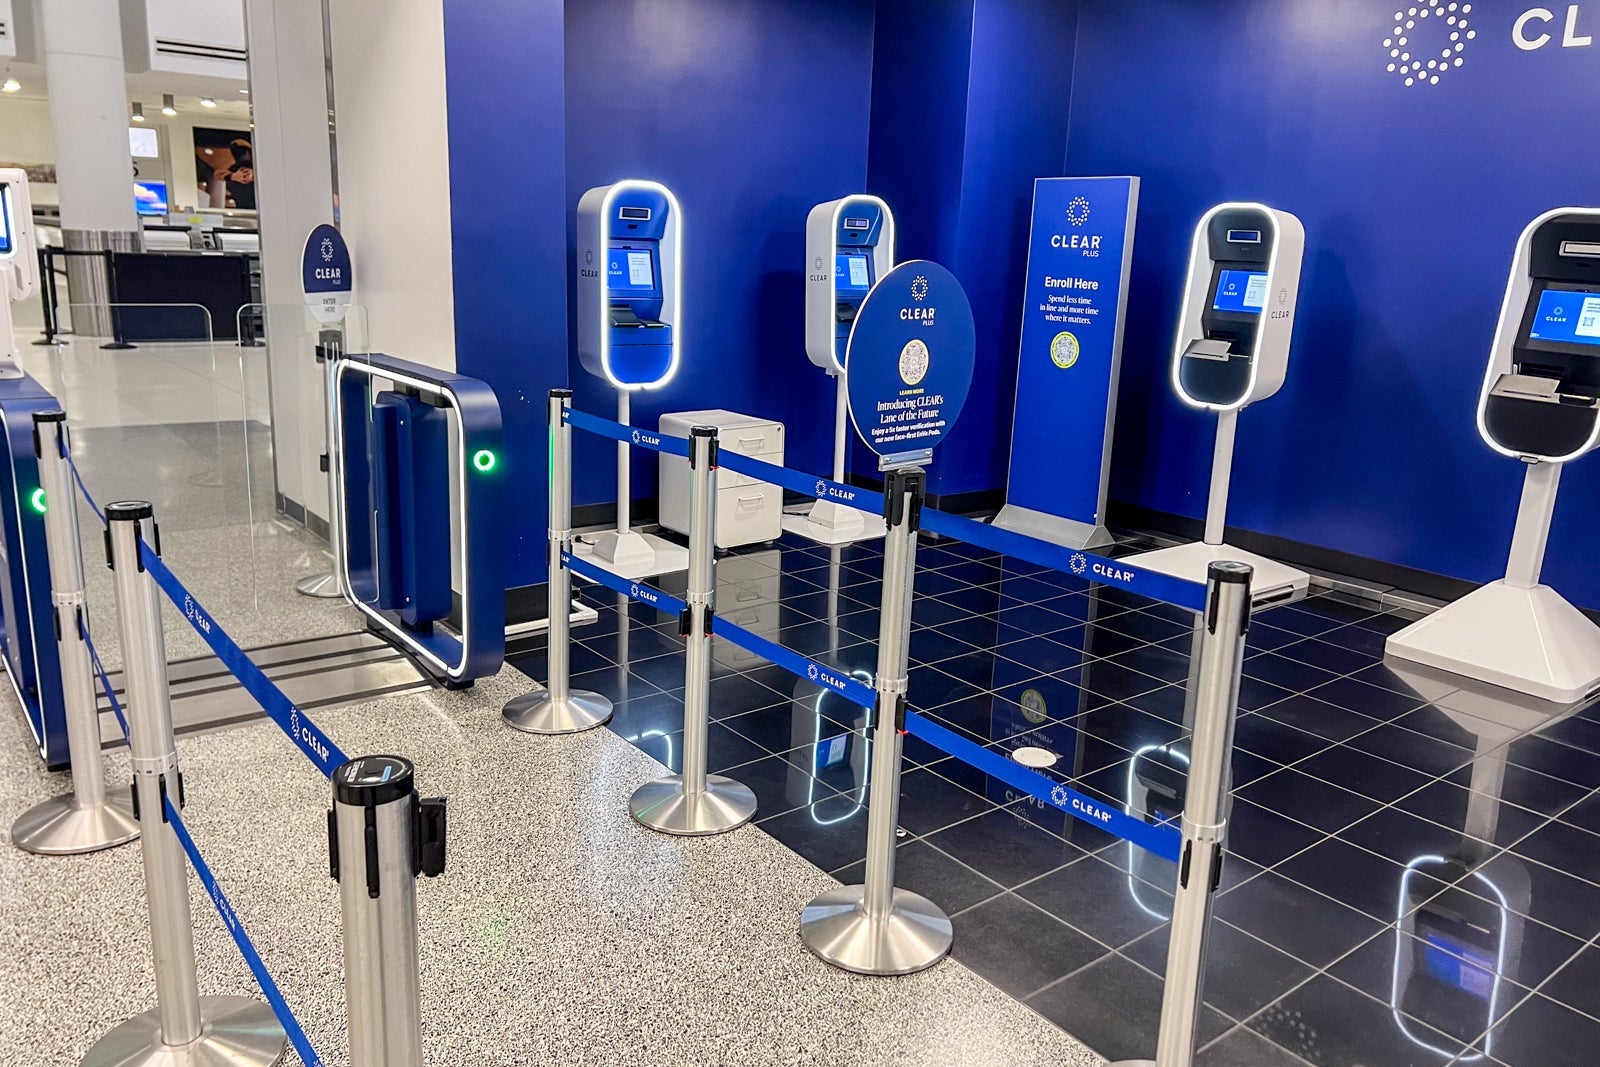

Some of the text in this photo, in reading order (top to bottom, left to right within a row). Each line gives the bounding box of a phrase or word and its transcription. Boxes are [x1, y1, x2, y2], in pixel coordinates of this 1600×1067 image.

[1051, 234, 1100, 249] CLEAR
[315, 267, 341, 279] CLEAR
[581, 269, 598, 278] CLEAR
[810, 274, 828, 282] CLEAR
[1044, 276, 1099, 290] Enroll Here
[1047, 294, 1092, 305] Spend less time
[900, 308, 935, 320] CLEAR
[1039, 303, 1046, 311] in
[1046, 303, 1057, 312] line
[1057, 305, 1069, 313] and
[1085, 307, 1099, 315] time
[1271, 310, 1290, 319] CLEAR
[1045, 313, 1062, 322] where
[1063, 314, 1068, 322] it
[877, 398, 917, 411] Introducing
[880, 409, 939, 424] Lane of the Future
[871, 428, 885, 436] Enjoy
[896, 424, 910, 432] faster
[910, 421, 935, 430] verification
[641, 435, 660, 445] CLEAR
[829, 487, 855, 501] CLEAR
[1092, 563, 1134, 582] CLEAR
[640, 590, 658, 603] CLEAR
[821, 673, 846, 690] CLEAR
[302, 727, 329, 763] CLEAR
[1072, 799, 1112, 823] CLEAR
